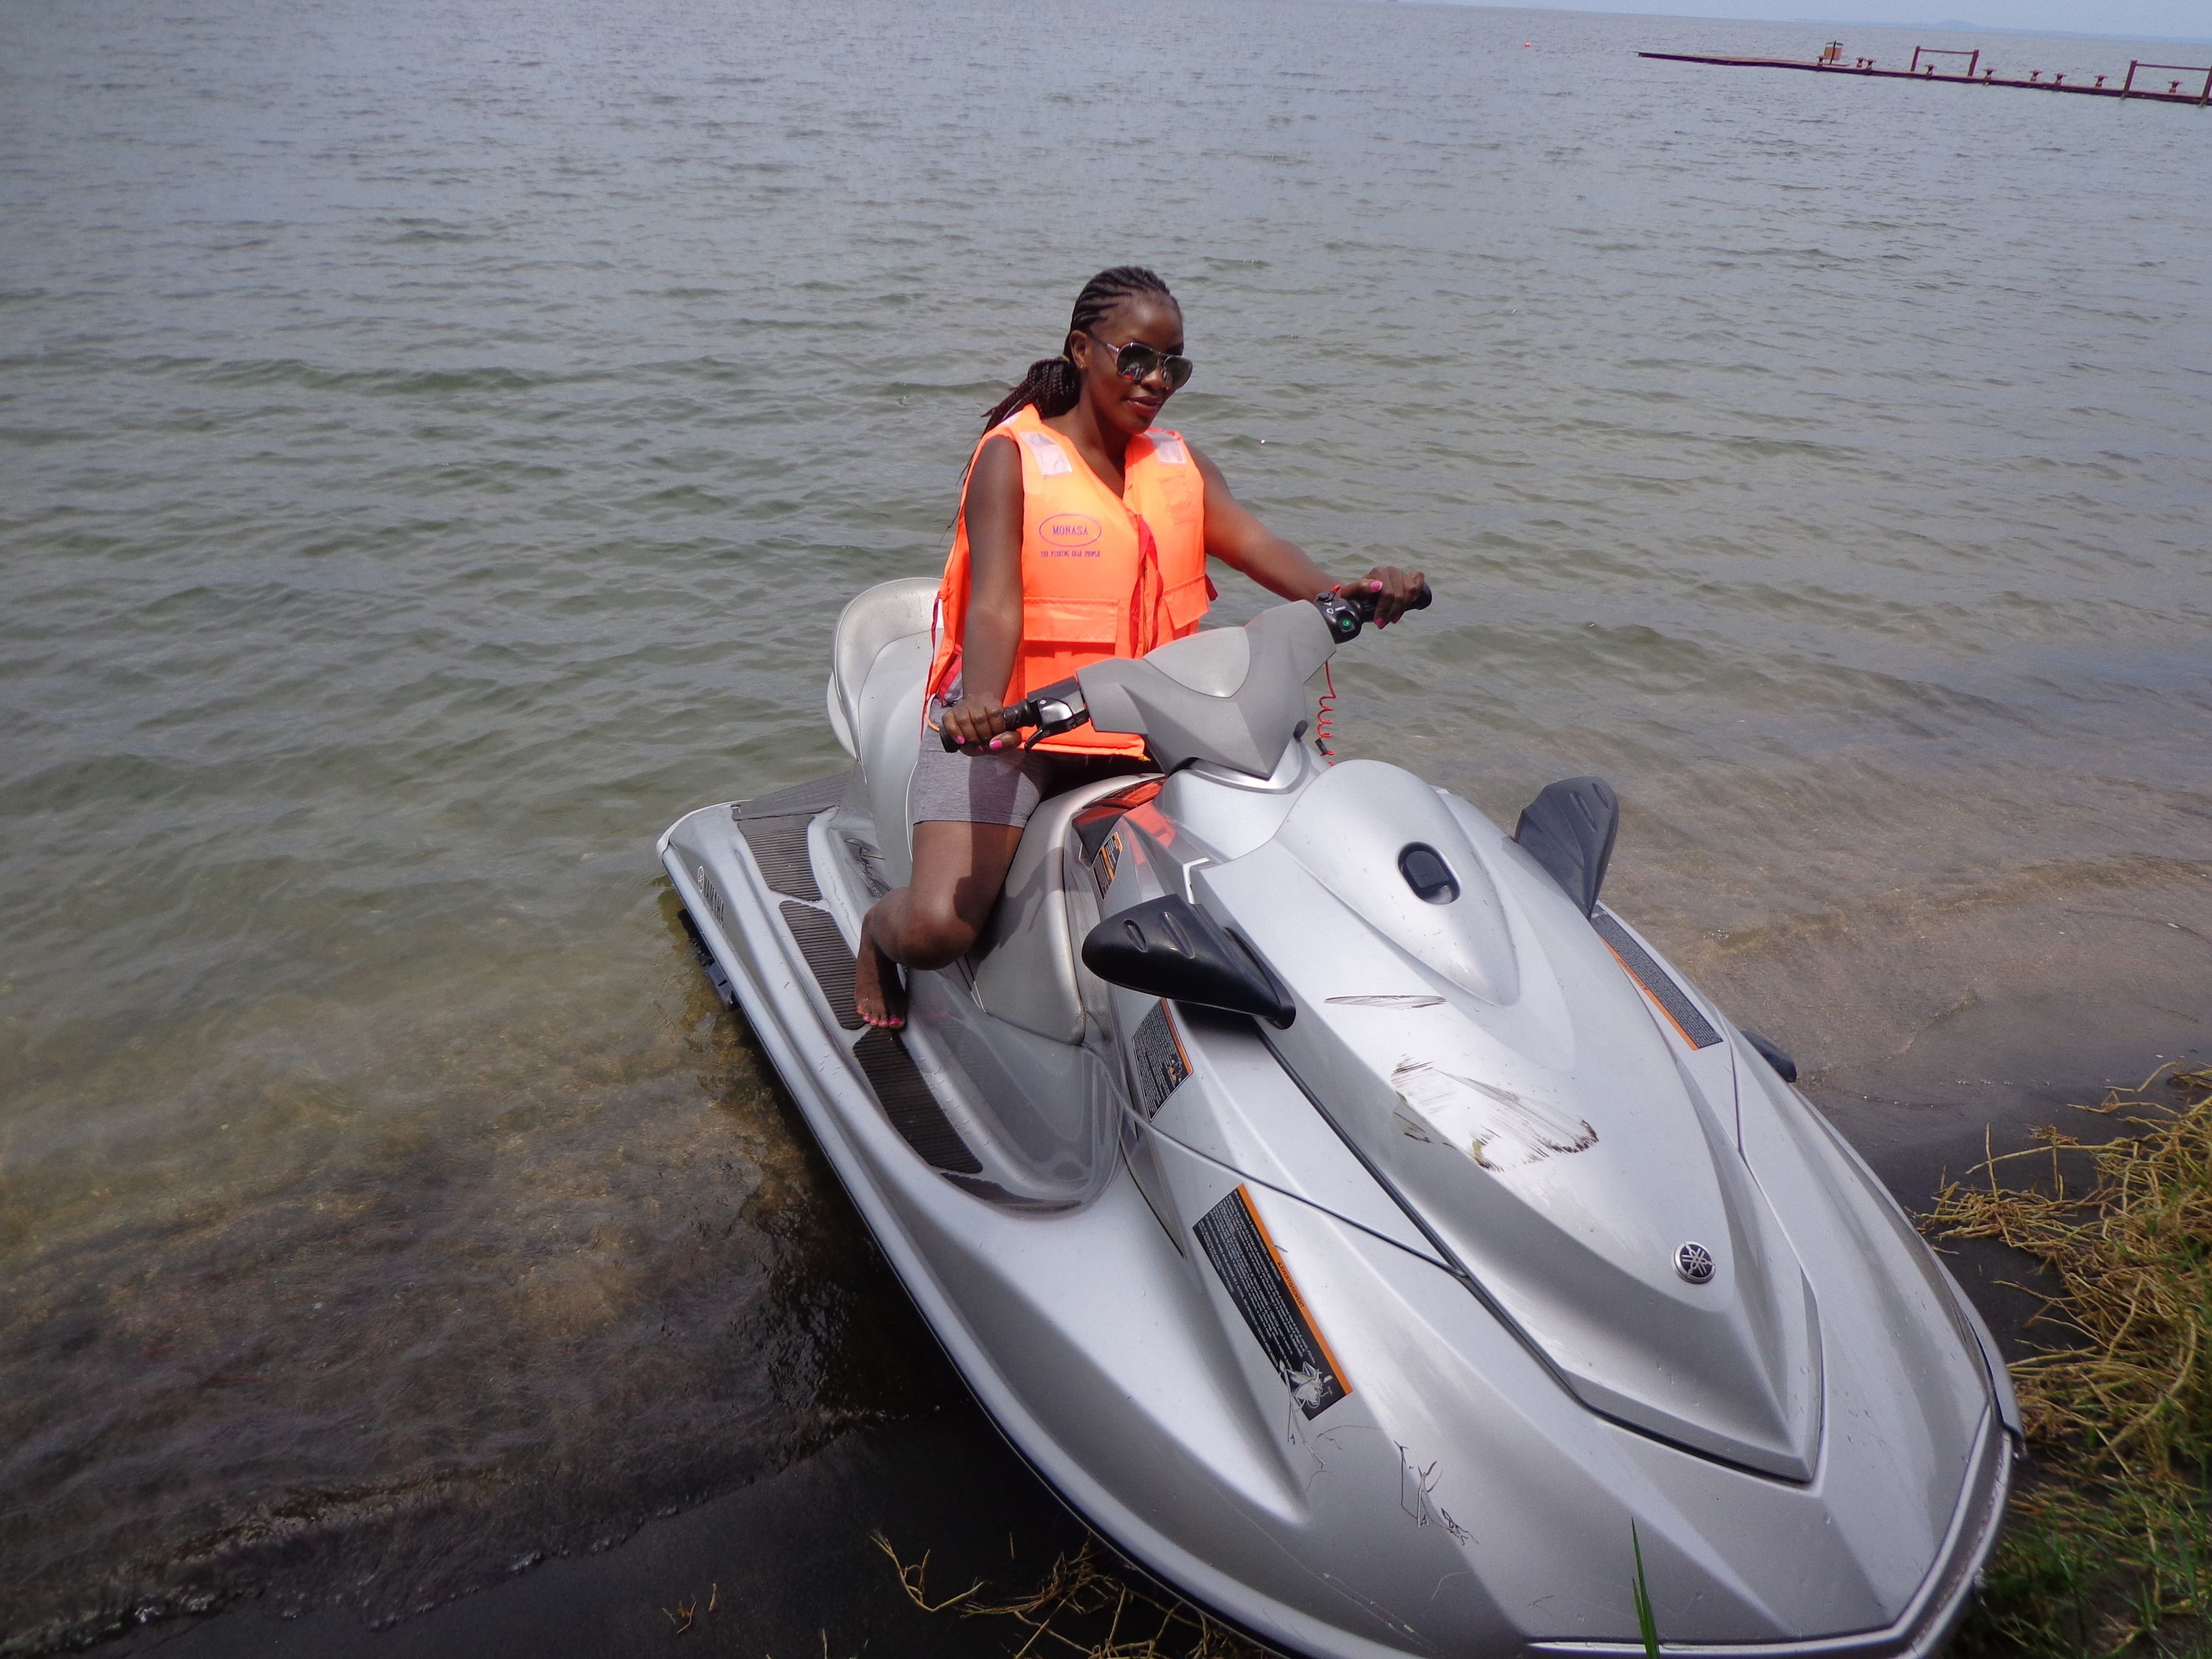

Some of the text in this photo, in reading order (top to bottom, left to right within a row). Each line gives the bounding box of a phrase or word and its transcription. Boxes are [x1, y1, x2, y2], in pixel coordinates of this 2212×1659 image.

[1053, 525, 1088, 536] MONASA
[704, 873, 724, 929] YAMAHA
[1278, 1264, 1305, 1309] AVERTISSEMENT
